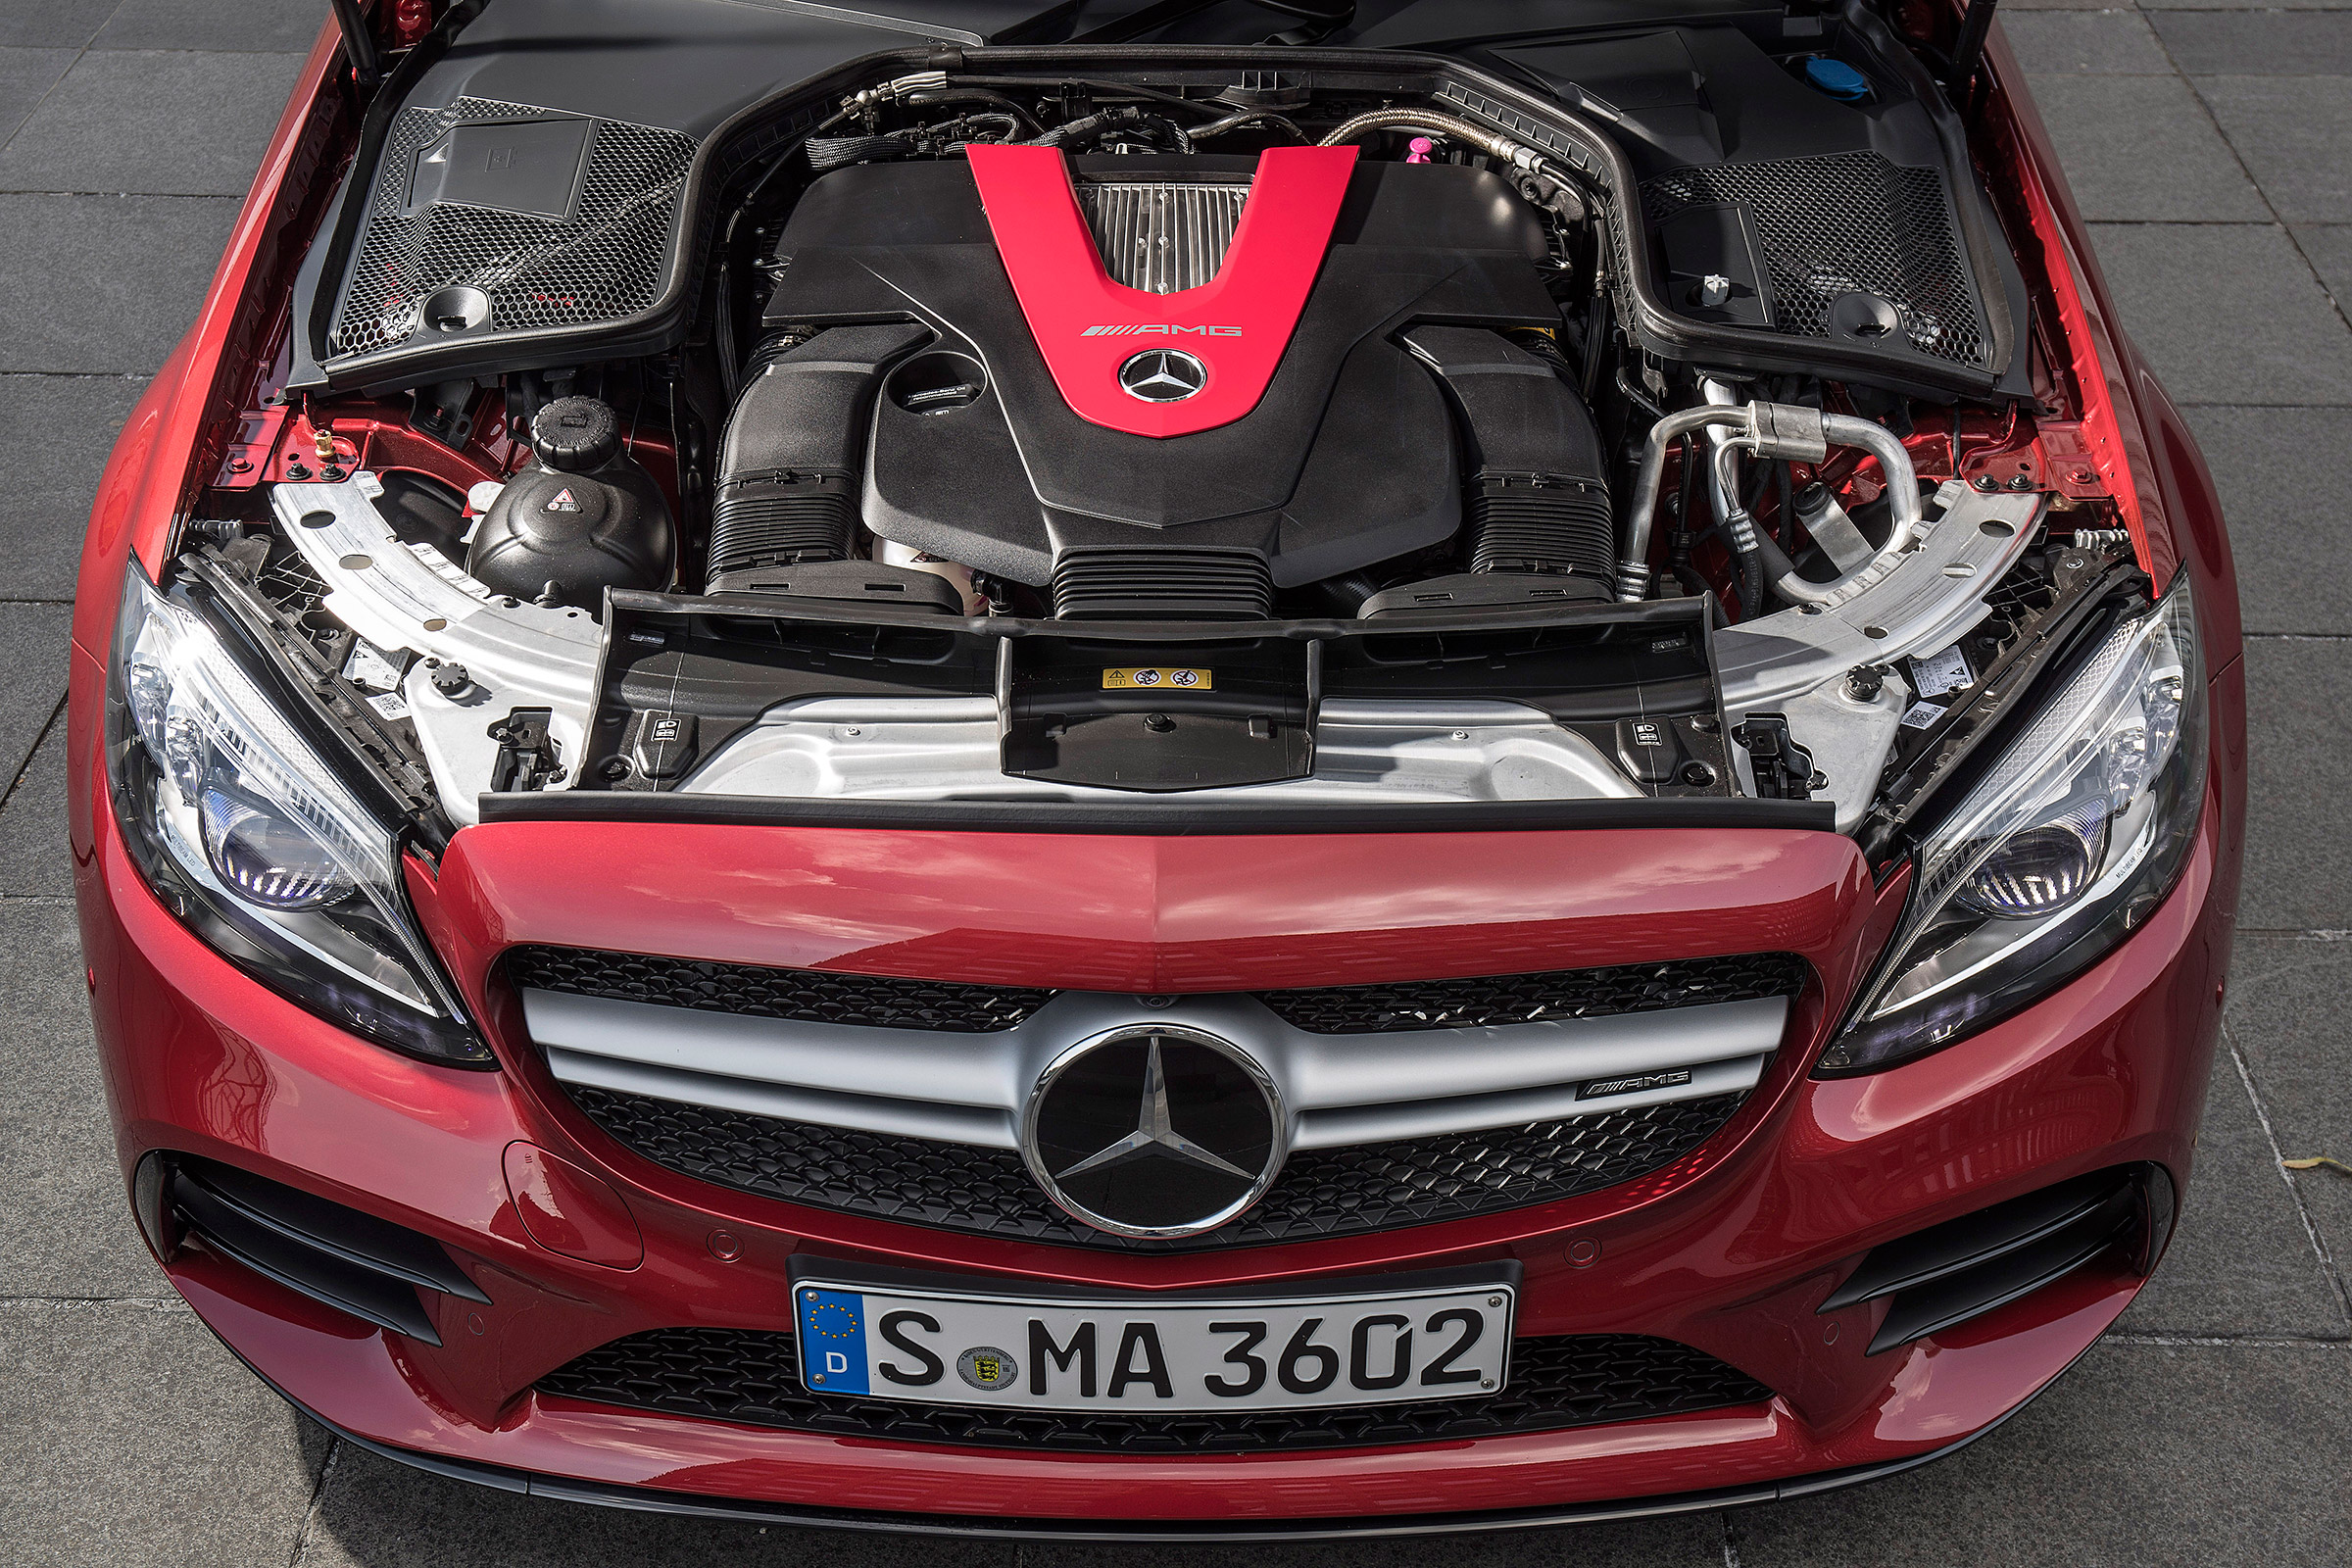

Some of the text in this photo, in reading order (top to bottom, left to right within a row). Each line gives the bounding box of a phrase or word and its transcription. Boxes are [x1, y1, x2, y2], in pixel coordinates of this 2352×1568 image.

[1132, 324, 1243, 337] AMG
[912, 391, 957, 401] recommended
[186, 856, 196, 867] LED
[2115, 856, 2136, 879] MULTIBEAM
[1620, 1070, 1690, 1091] AMG
[825, 1350, 848, 1373] D
[878, 1308, 1484, 1398] S MA 3602
